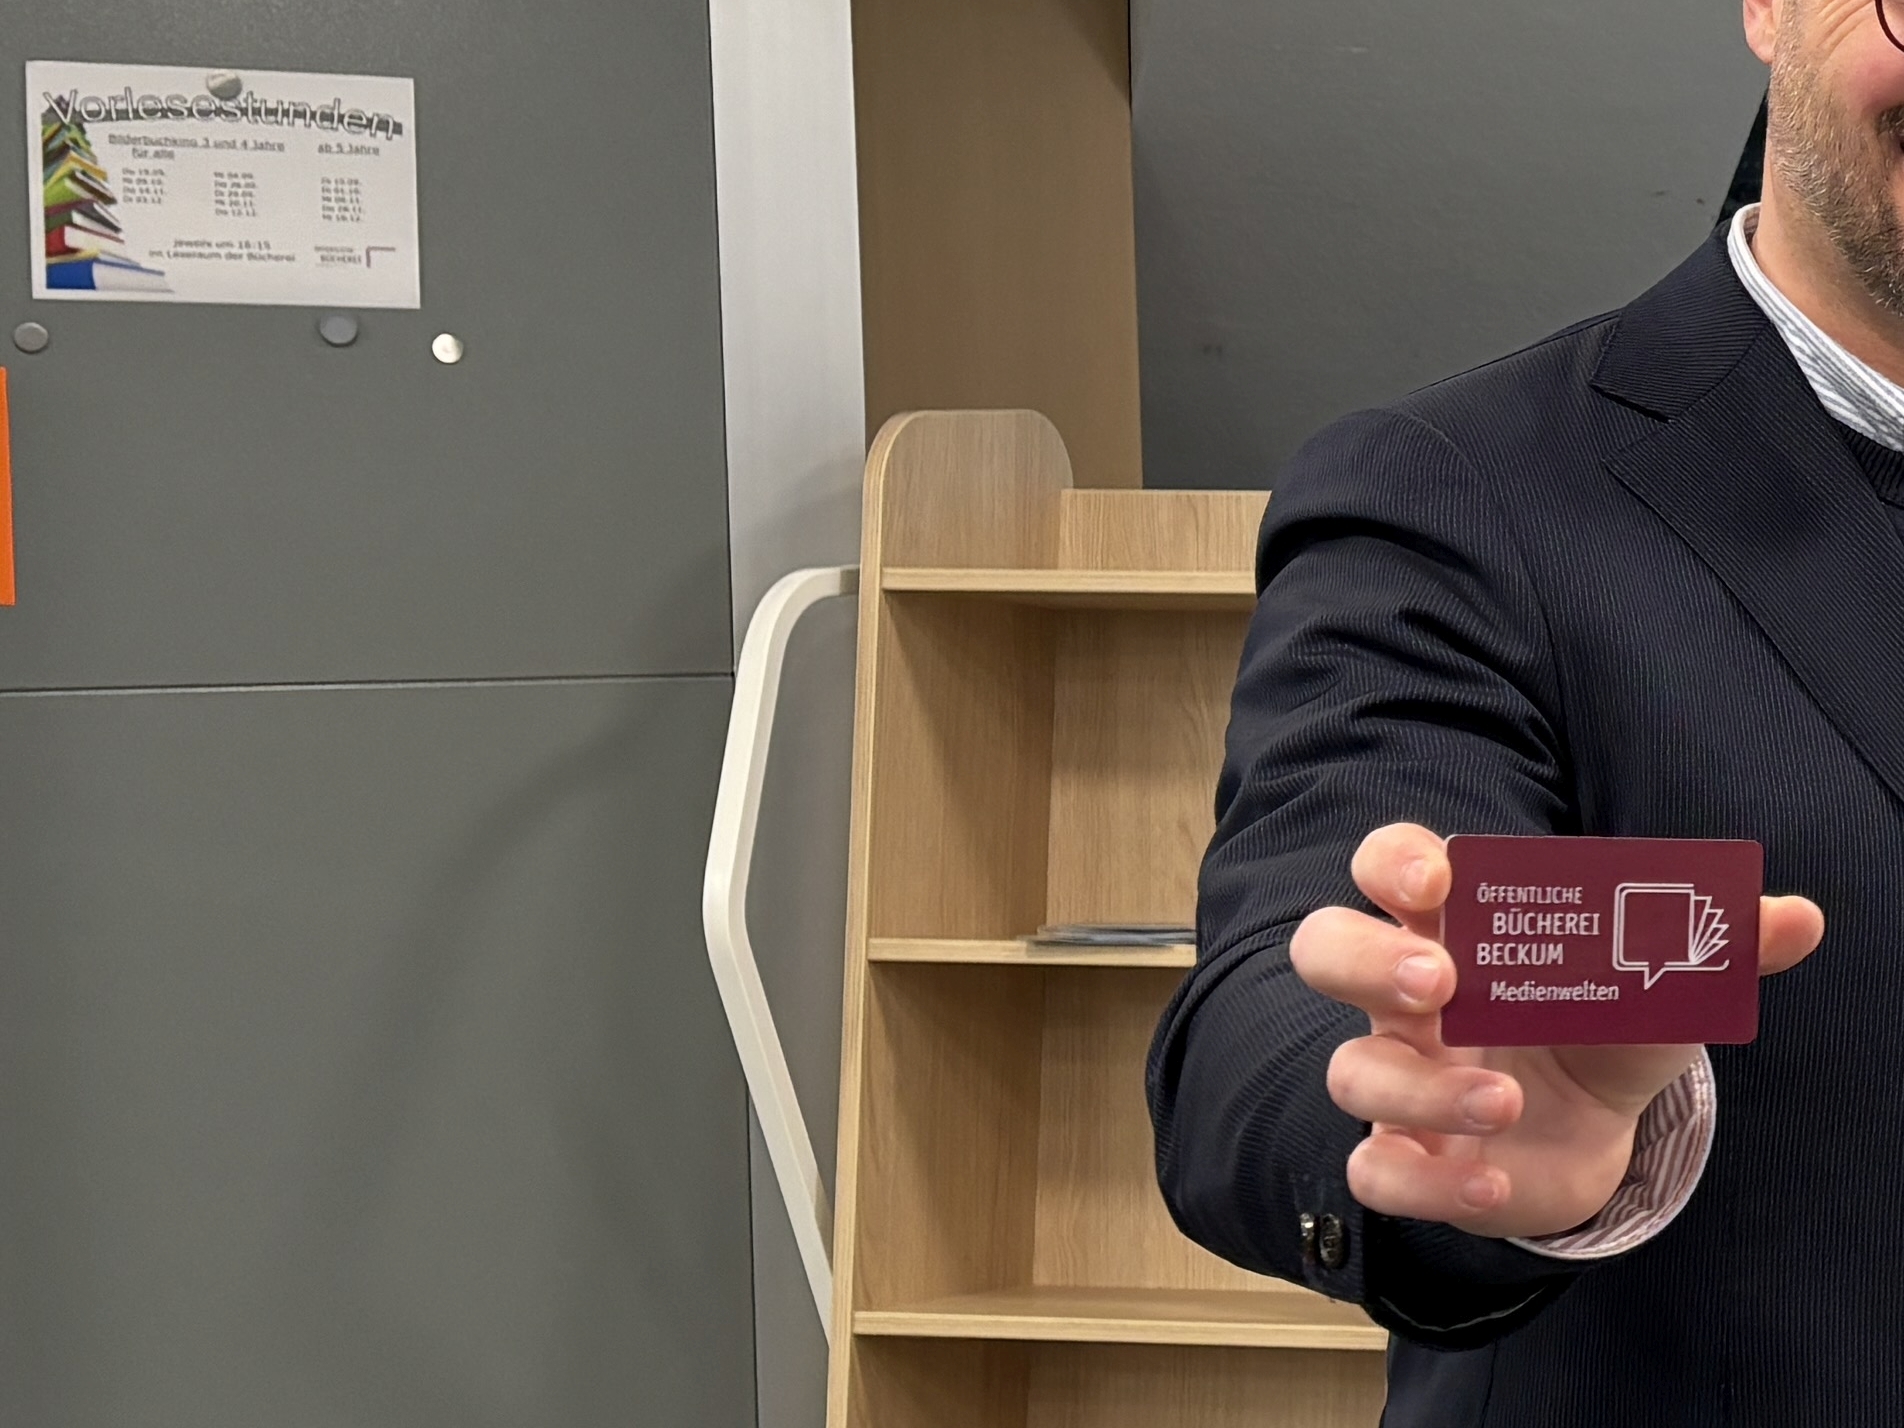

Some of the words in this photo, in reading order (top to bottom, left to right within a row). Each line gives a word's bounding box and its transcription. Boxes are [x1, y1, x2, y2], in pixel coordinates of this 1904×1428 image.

[42, 84, 399, 141] Vorlesestunden
[1477, 882, 1583, 905] ÖFFENTLICHE
[1493, 908, 1600, 937] BÜCHEREI
[1476, 942, 1564, 966] BECKUM
[1489, 980, 1620, 1002] Medienwelten
